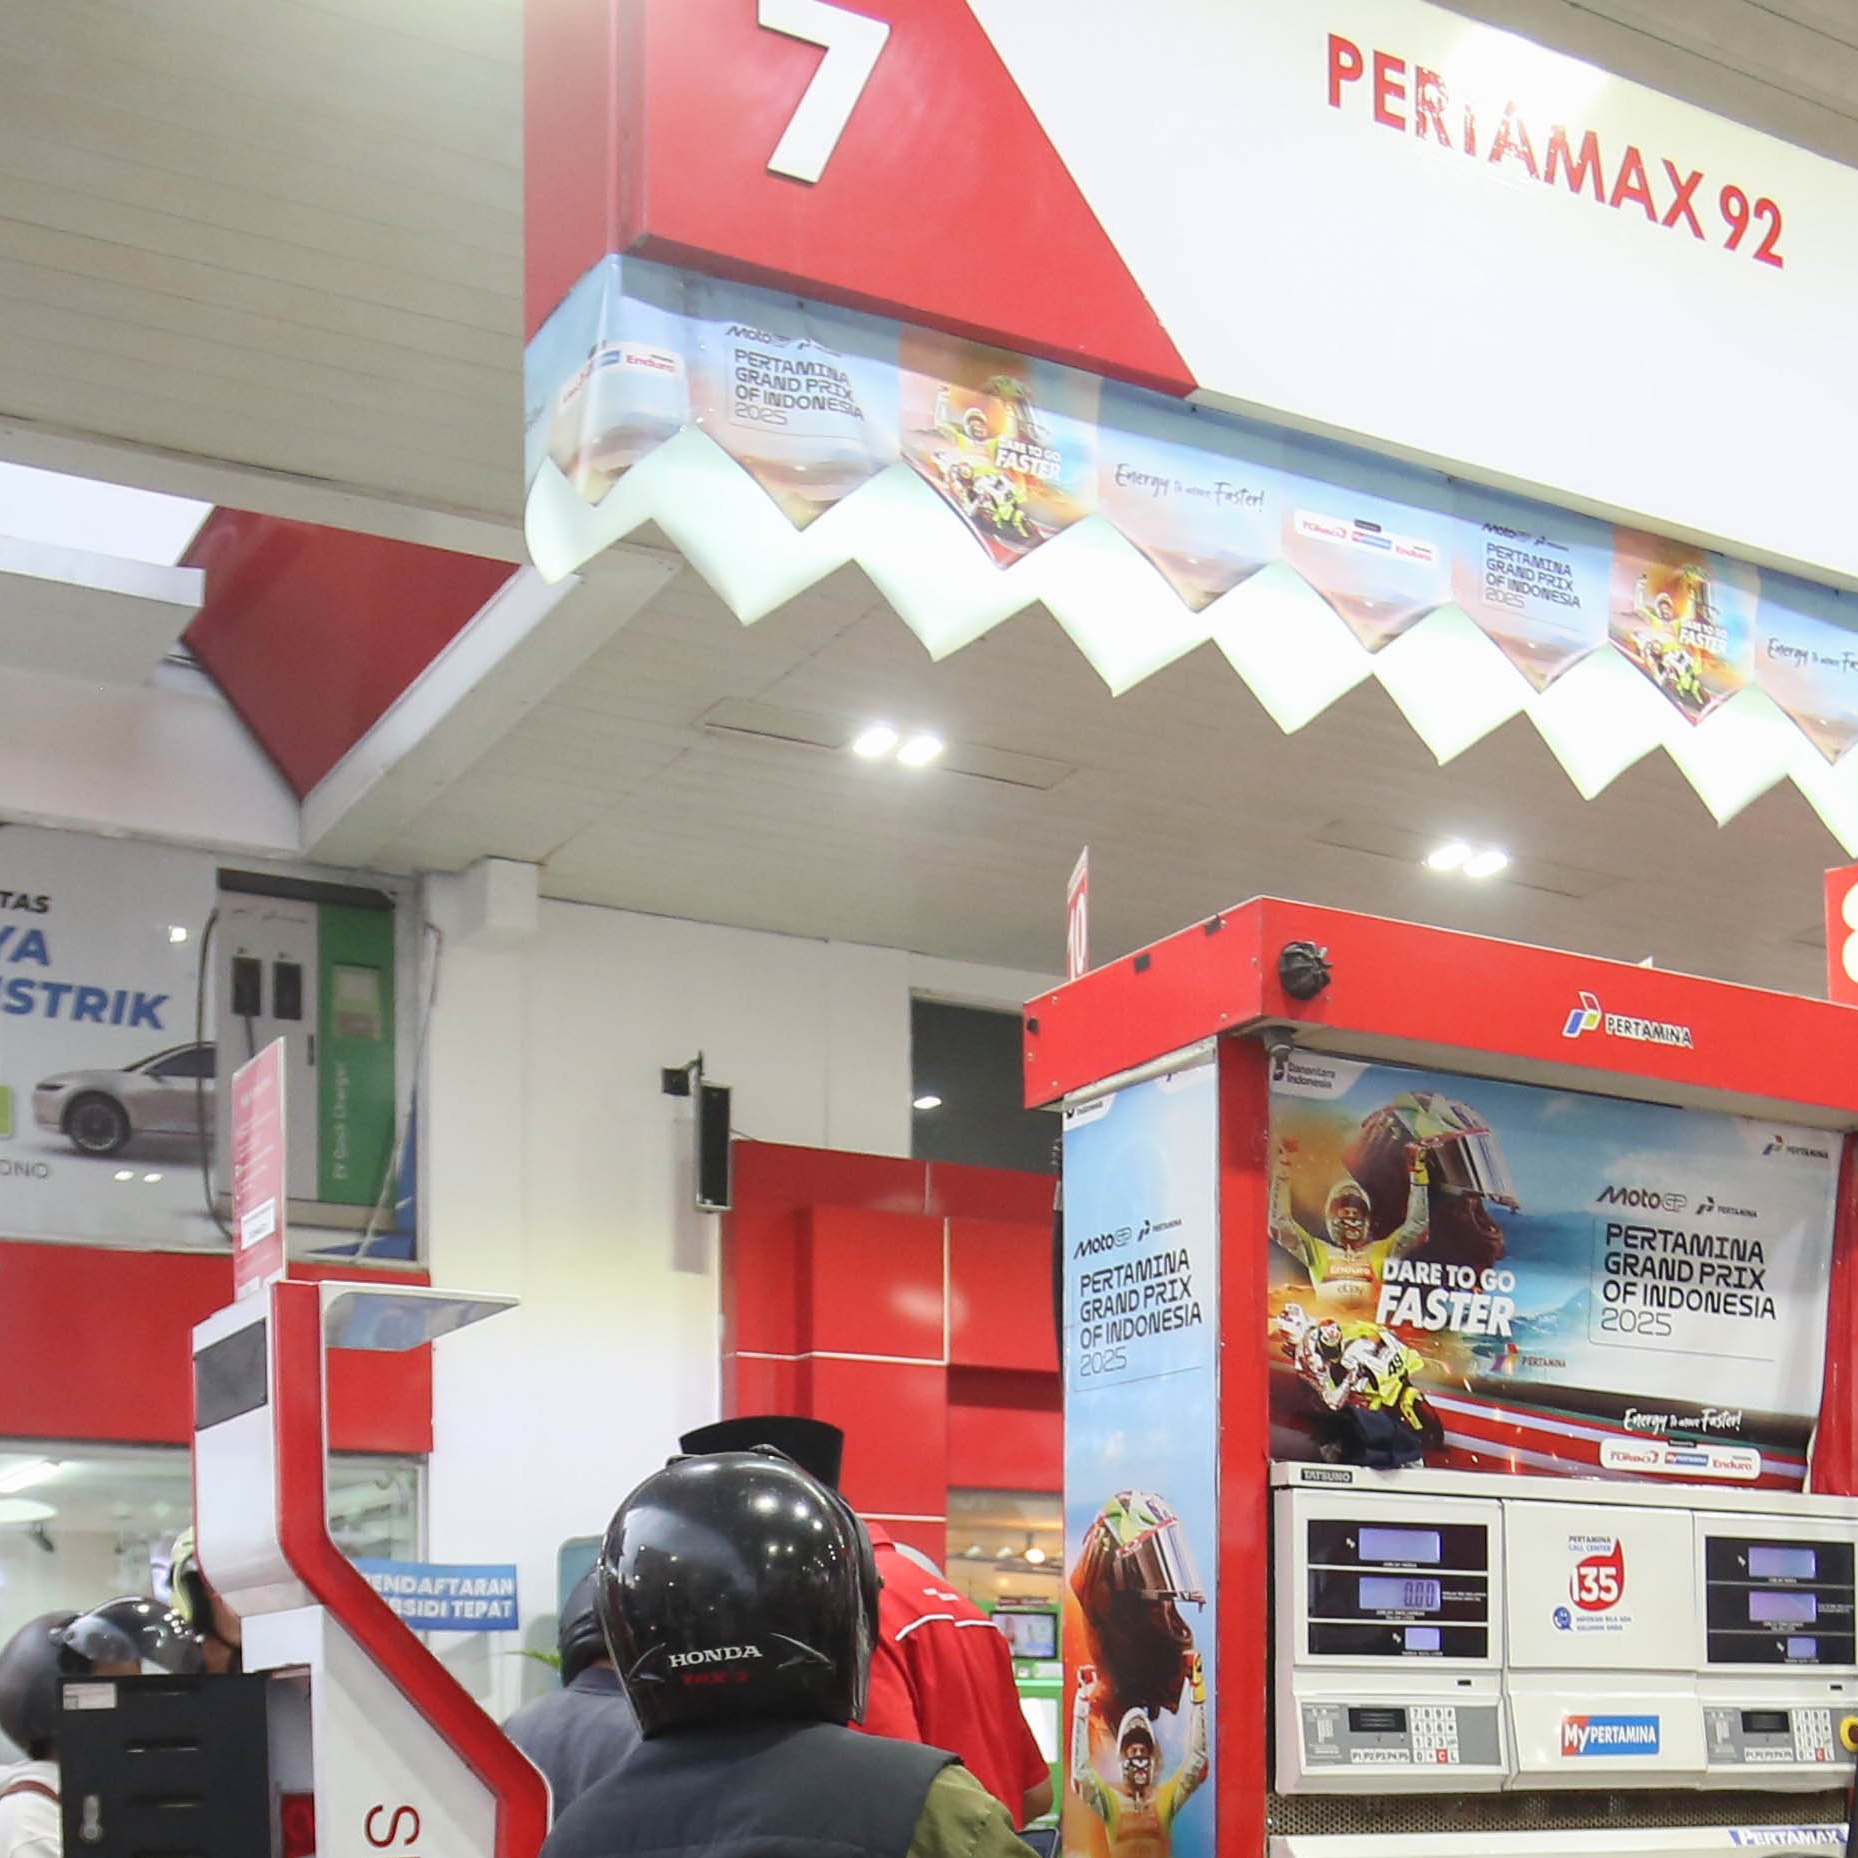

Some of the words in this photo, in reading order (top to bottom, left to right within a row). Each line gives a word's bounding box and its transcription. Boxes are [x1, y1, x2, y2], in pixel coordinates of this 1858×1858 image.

[755, 0, 891, 184] 7
[1327, 31, 1705, 241] PERTAMAX
[1719, 184, 1784, 268] 92
[734, 348, 850, 385] PERTAMINA
[735, 366, 801, 395] GRAND
[804, 377, 853, 400] PRIX
[735, 385, 759, 405] OF
[762, 387, 865, 421] INDONESIA
[1485, 542, 1573, 578] PERTAMINA
[1485, 557, 1534, 583] GRAND
[1536, 565, 1574, 591] PRIX
[1485, 571, 1506, 591] OF
[1507, 574, 1581, 610] INDONESIA
[1606, 1015, 1693, 1048] PERTAMINA
[1604, 1221, 1765, 1266] PERTAMINA
[1079, 1246, 1191, 1299] PERTAMINA
[1382, 1258, 1443, 1286] DARE
[1446, 1262, 1477, 1289] TO
[1479, 1266, 1516, 1293] GO
[1603, 1251, 1694, 1284] GRAND
[1699, 1263, 1767, 1292] PRIX
[1079, 1284, 1140, 1325] GRAND
[1141, 1273, 1194, 1307] PRIX
[1374, 1284, 1517, 1338] FASTER
[1602, 1279, 1638, 1304] OF
[1643, 1283, 1778, 1322] INDONESIA
[1079, 1324, 1105, 1350] OF
[1105, 1301, 1203, 1348] INDONESIA
[1600, 1307, 1673, 1338] 2025
[1079, 1344, 1129, 1379] 2025
[365, 1573, 513, 1597] ENDAFTARAN
[1571, 1566, 1620, 1603] 135
[450, 1600, 513, 1619] TEPAT
[668, 1645, 763, 1668] HONDA
[1743, 1829, 1841, 1847] PERTAMAX
